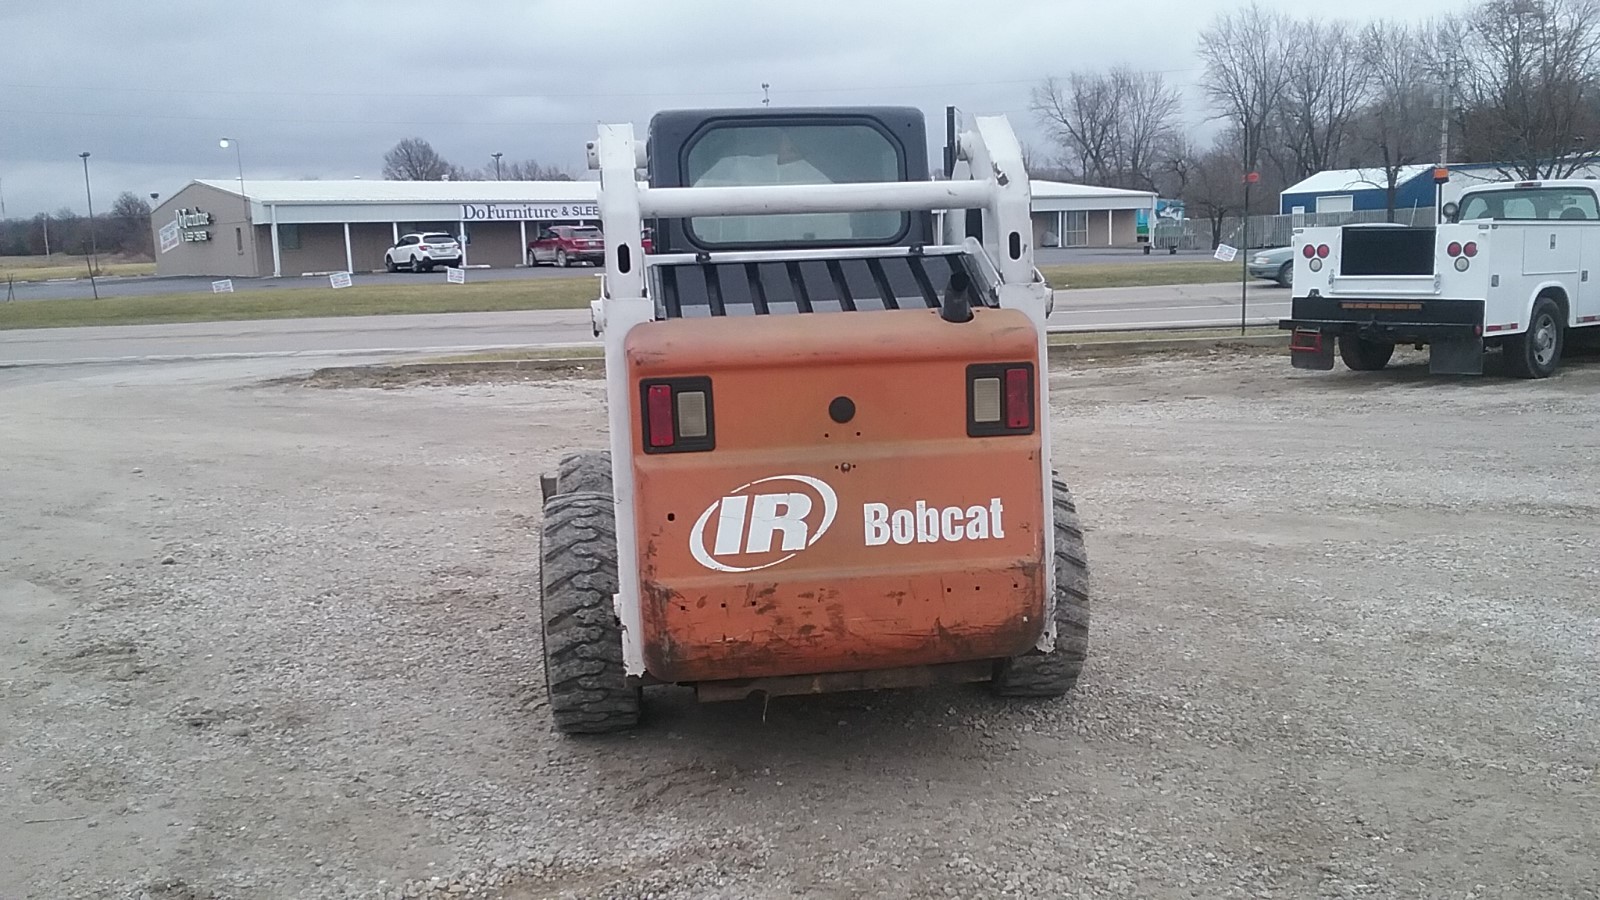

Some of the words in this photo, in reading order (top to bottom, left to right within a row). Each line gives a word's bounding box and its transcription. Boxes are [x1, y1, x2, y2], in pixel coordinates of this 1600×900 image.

[561, 206, 569, 216] &
[714, 493, 812, 556] IR
[864, 497, 1005, 546] Bobcat
